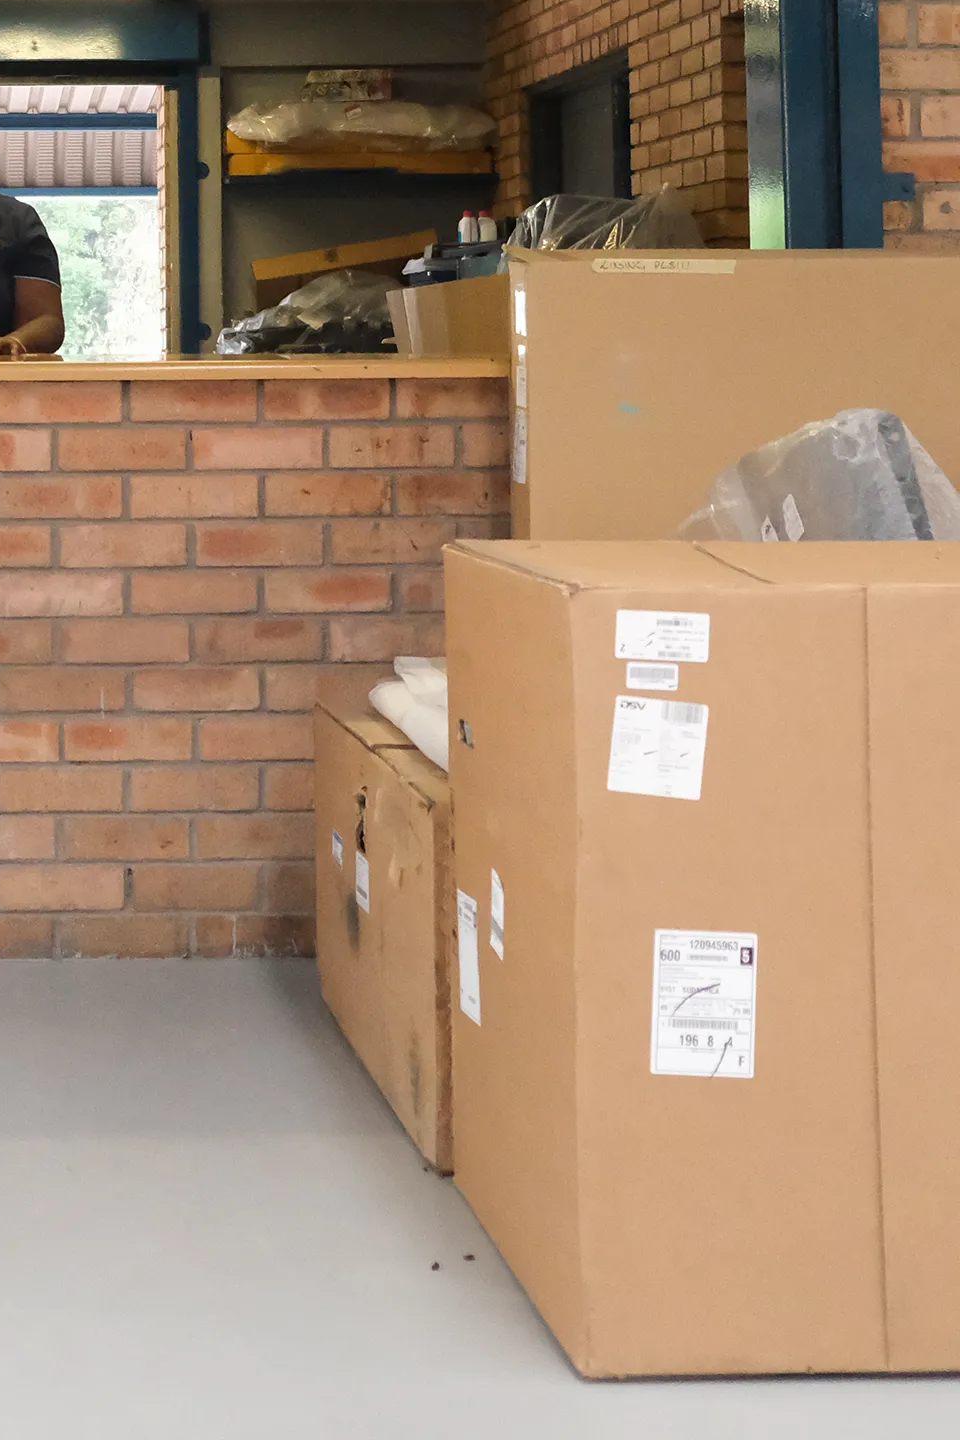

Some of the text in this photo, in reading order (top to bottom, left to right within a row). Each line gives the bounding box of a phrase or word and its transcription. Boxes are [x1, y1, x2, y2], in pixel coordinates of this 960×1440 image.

[620, 699, 647, 711] DSV
[659, 949, 681, 962] 600
[679, 1034, 699, 1048] 196
[707, 1035, 714, 1048] 8
